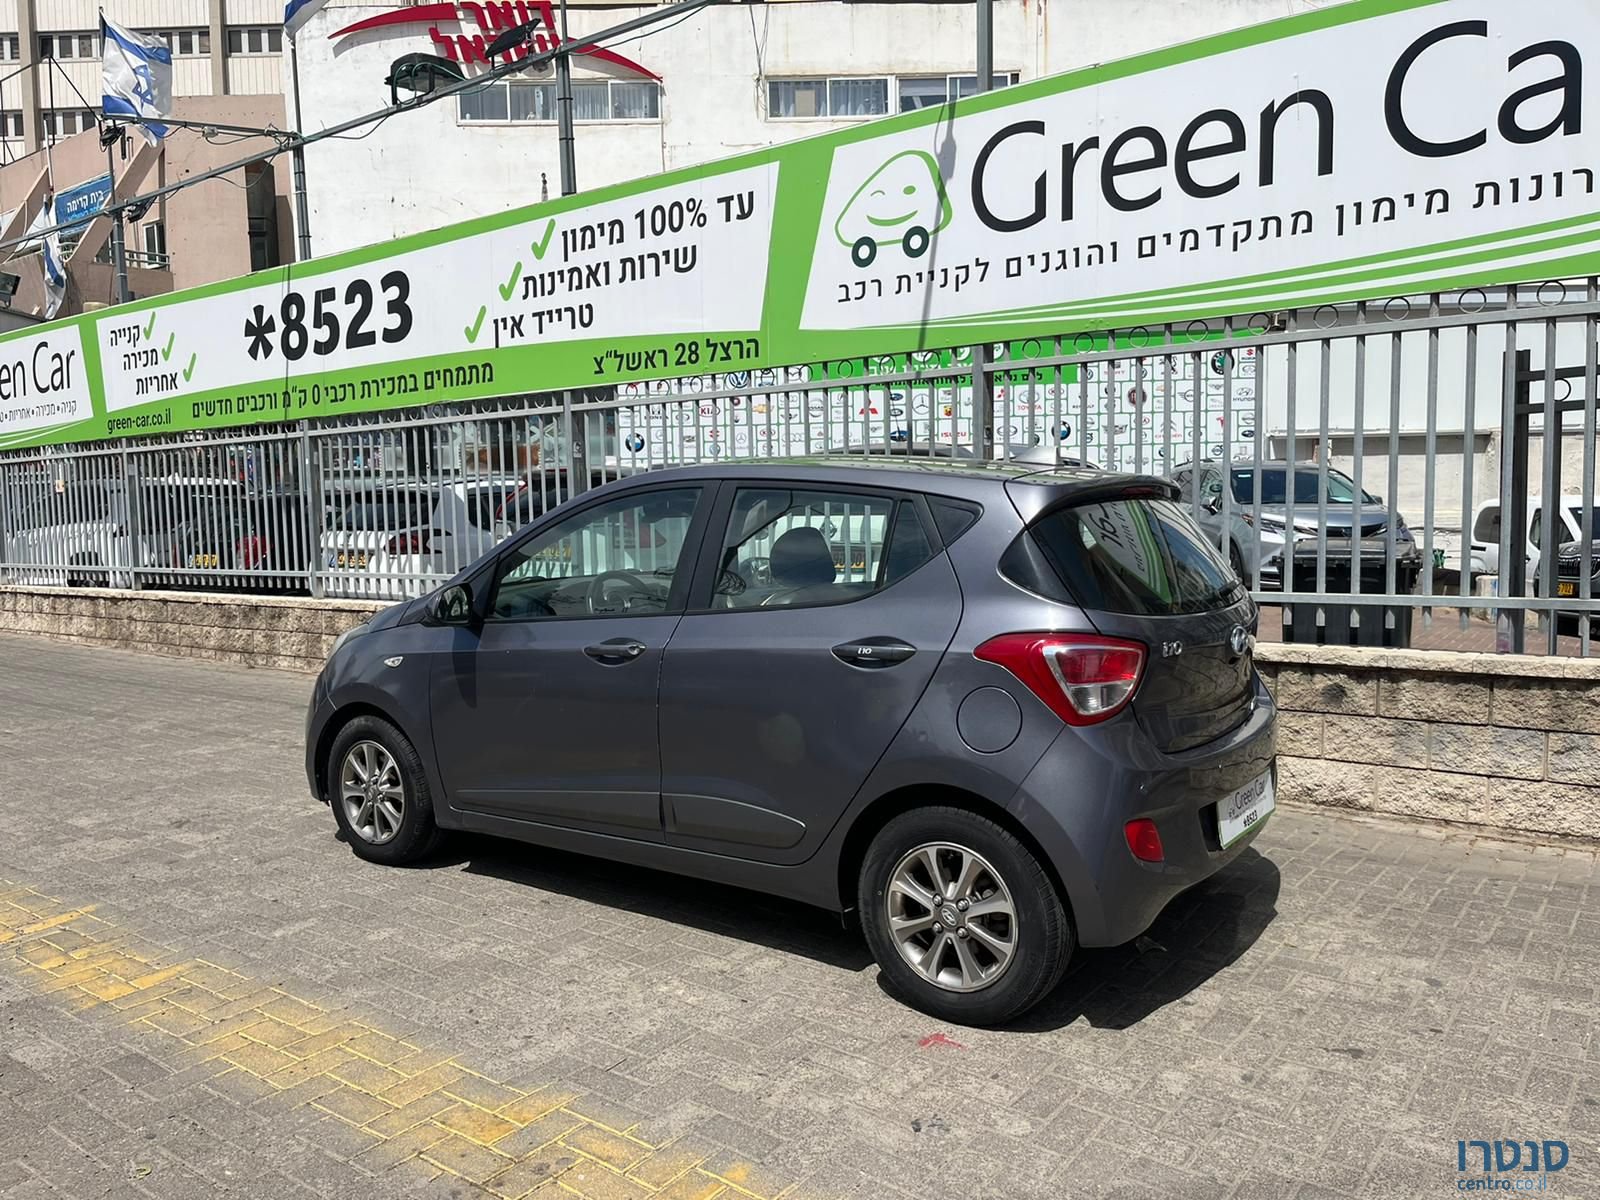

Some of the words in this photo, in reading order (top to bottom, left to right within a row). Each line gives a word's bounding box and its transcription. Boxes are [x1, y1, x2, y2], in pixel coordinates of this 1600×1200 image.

[971, 88, 1334, 233] Green
[1384, 20, 1583, 158] Ca
[1473, 167, 1593, 208] רונות
[635, 198, 707, 239] 100%
[717, 191, 754, 223] עד
[1336, 188, 1449, 236] מימון
[561, 219, 625, 262] מימון
[1138, 209, 1313, 258] מתקדמים
[619, 245, 697, 284] שירות
[1006, 241, 1117, 279] והוגנים
[522, 257, 610, 300] ואמינות
[838, 278, 882, 303] רכב
[895, 257, 990, 295] לקניית
[493, 314, 525, 348] אין
[532, 303, 594, 334] טרייד
[110, 325, 140, 347] קנייה
[705, 337, 759, 363] הרצל
[32, 341, 75, 394] Car
[123, 349, 158, 370] מכירה
[674, 343, 700, 366] 28
[136, 372, 178, 395] אחריות
[360, 374, 418, 399] במכירת
[424, 362, 494, 390] מתמחים
[192, 397, 232, 418] חדשים
[237, 393, 277, 414] ורכבים
[311, 384, 320, 405] 0
[324, 383, 356, 403] רכבי
